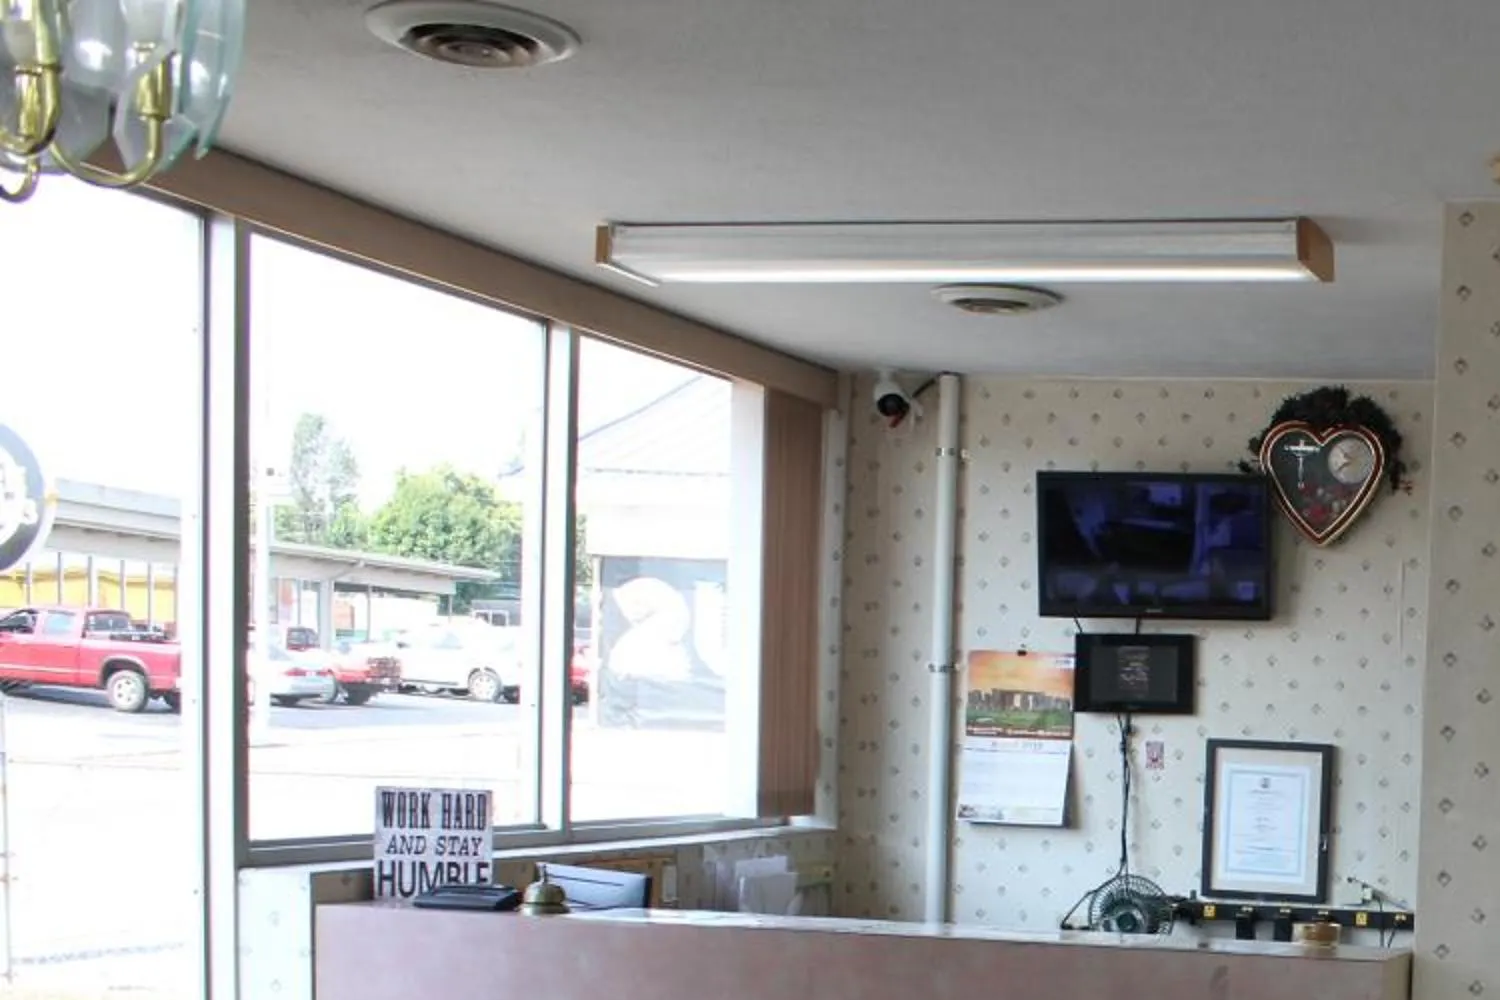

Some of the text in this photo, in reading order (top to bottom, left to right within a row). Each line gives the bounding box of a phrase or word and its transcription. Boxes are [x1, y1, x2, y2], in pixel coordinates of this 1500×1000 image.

[381, 791, 487, 831] WORK HARD
[385, 834, 483, 857] AND STAY
